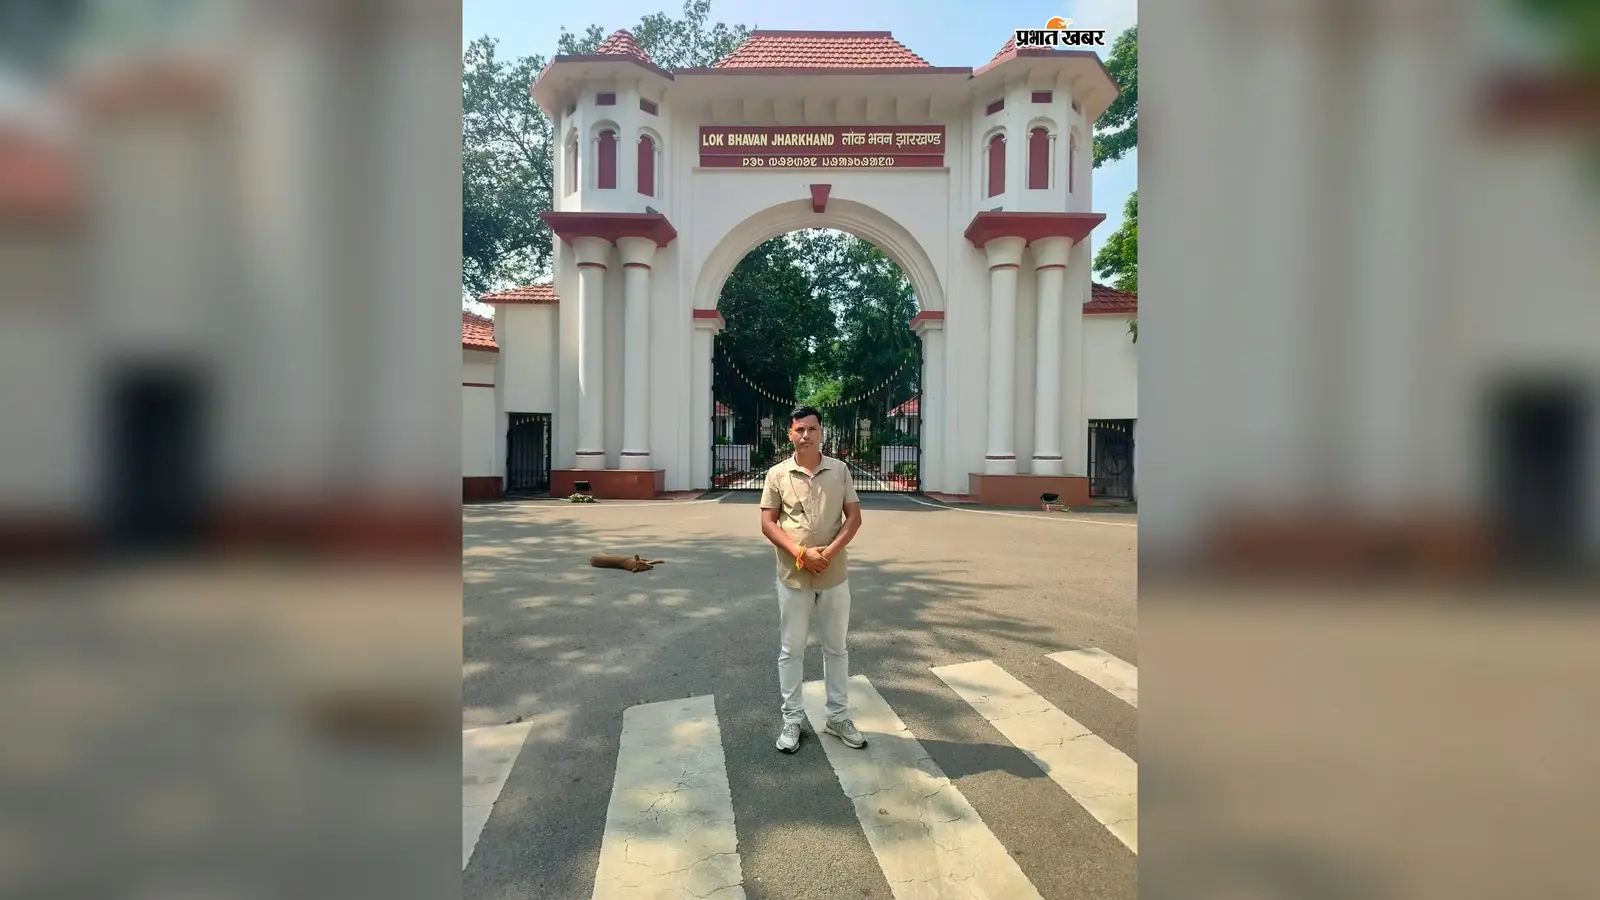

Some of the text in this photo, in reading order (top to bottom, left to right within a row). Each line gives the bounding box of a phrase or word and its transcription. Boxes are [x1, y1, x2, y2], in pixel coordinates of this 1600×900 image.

[702, 133, 835, 147] LOK BHAVAN JHARKHAND
[841, 130, 942, 148] लोक भवन झारखण्ड
